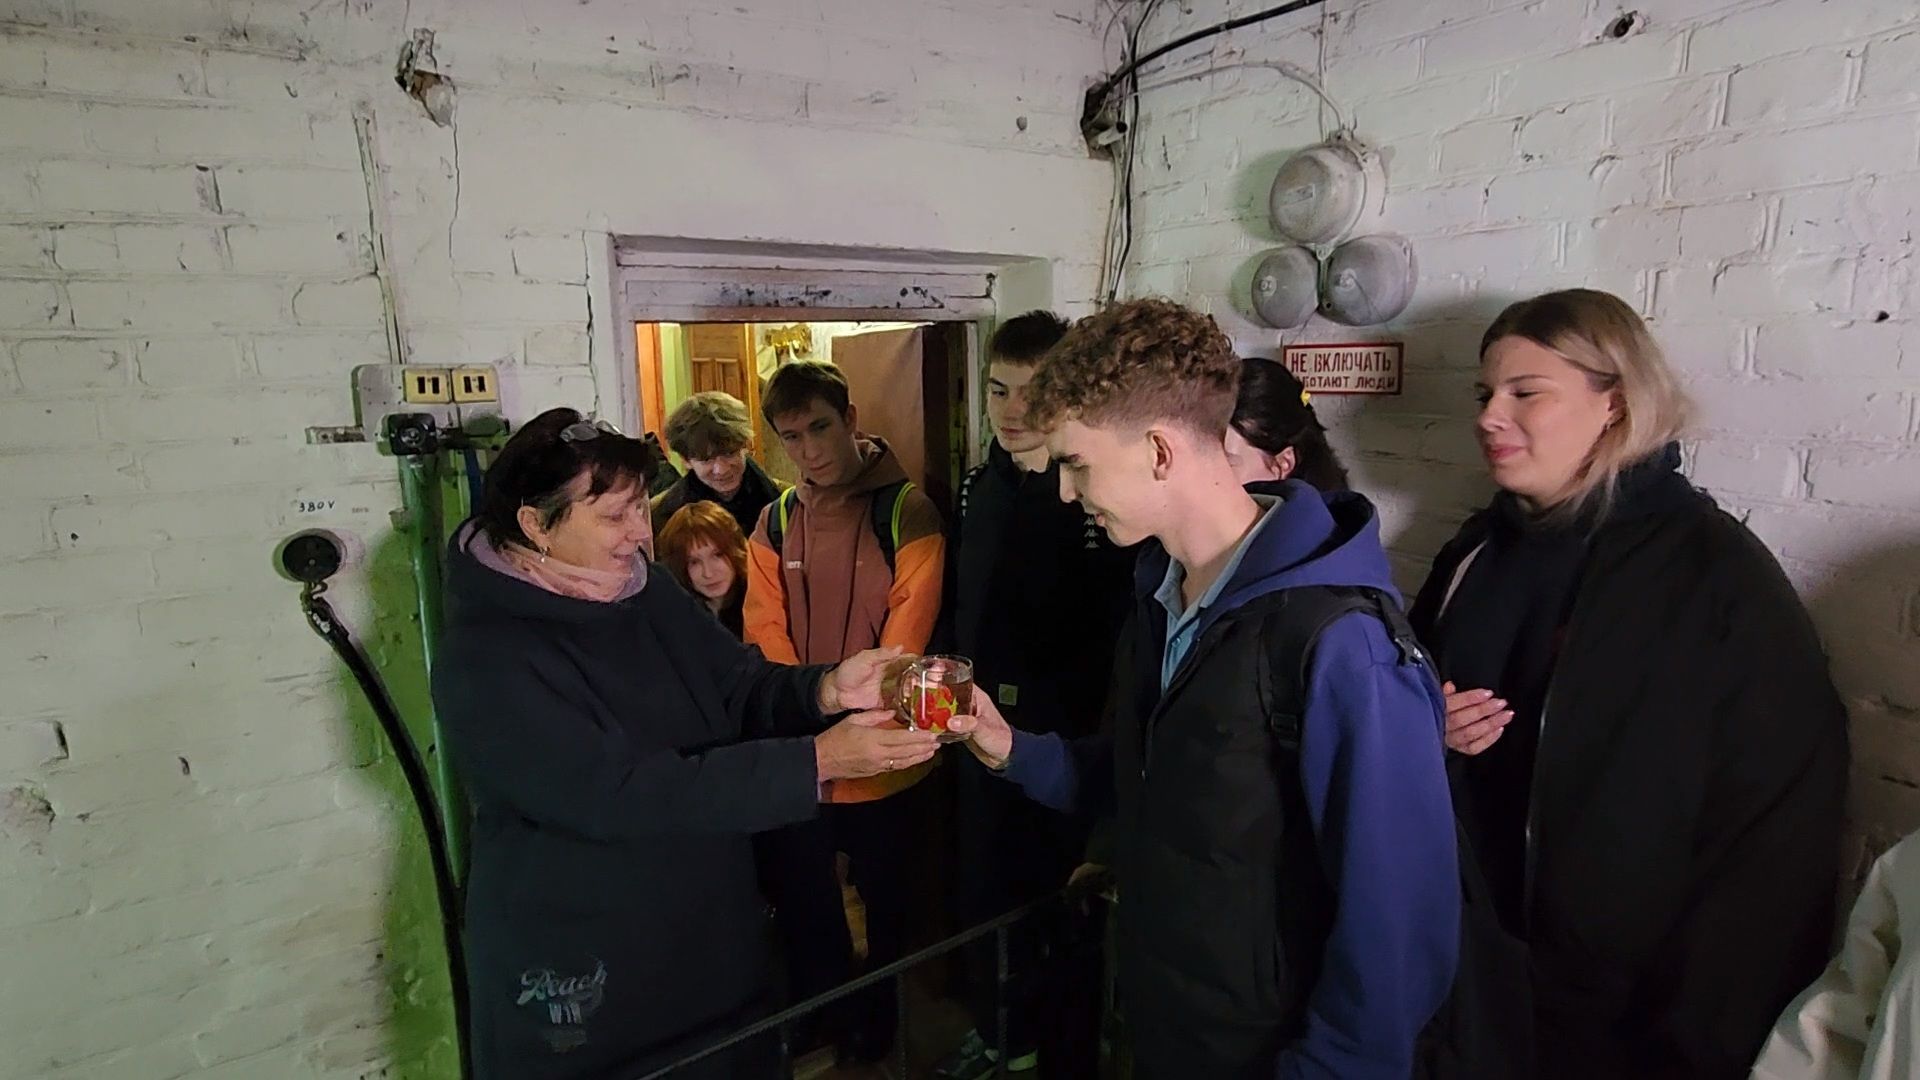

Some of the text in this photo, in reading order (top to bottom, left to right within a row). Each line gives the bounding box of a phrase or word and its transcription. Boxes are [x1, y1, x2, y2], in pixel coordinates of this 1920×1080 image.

[1291, 351, 1392, 373] НЕ ВКЛЮЧАТЬ
[1355, 376, 1396, 389] ЛЮДИ
